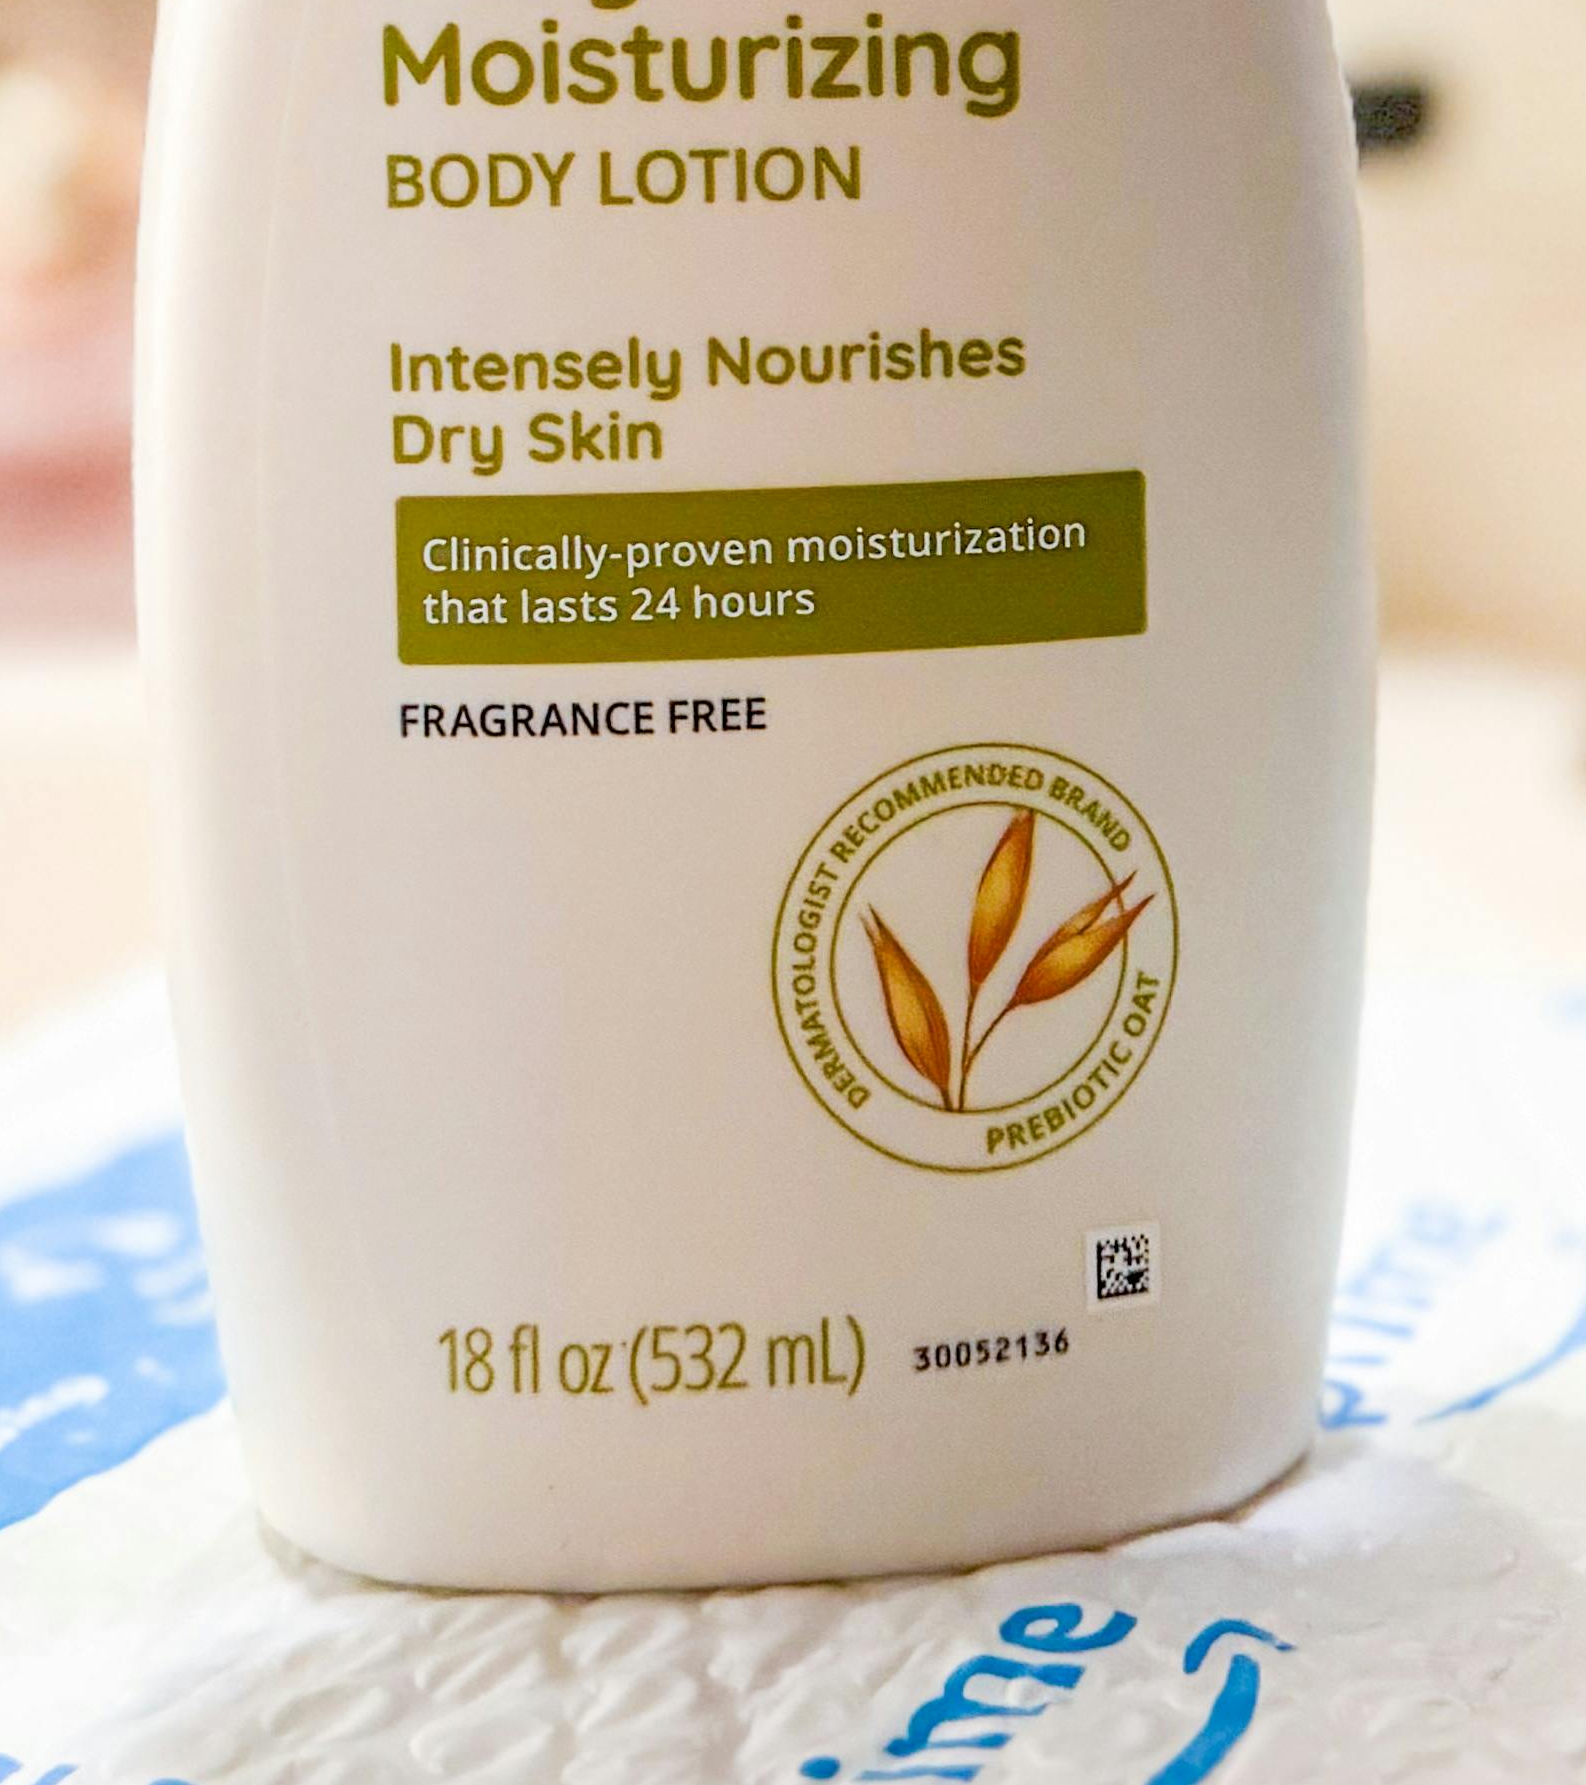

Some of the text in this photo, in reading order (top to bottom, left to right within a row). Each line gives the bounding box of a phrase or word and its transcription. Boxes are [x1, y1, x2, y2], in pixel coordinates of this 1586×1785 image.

[381, 11, 1023, 121] Moisturizing
[386, 145, 862, 211] BODY LOTION
[390, 327, 1028, 403] Intensely Nourishes
[392, 409, 664, 478] Dry Skin
[422, 518, 1087, 582] Clinically-proven moisturization
[423, 583, 817, 627] that lasts 24 hours
[400, 696, 769, 740] FRAGRANCE FREE
[791, 762, 1133, 1110] DERMATOLOGIST RECOMMENDED BRAND
[985, 970, 1162, 1155] PREBIOTIC OAT
[439, 1314, 868, 1407] 18 fl oz (532 mL)
[913, 1327, 1071, 1373] 30052136
